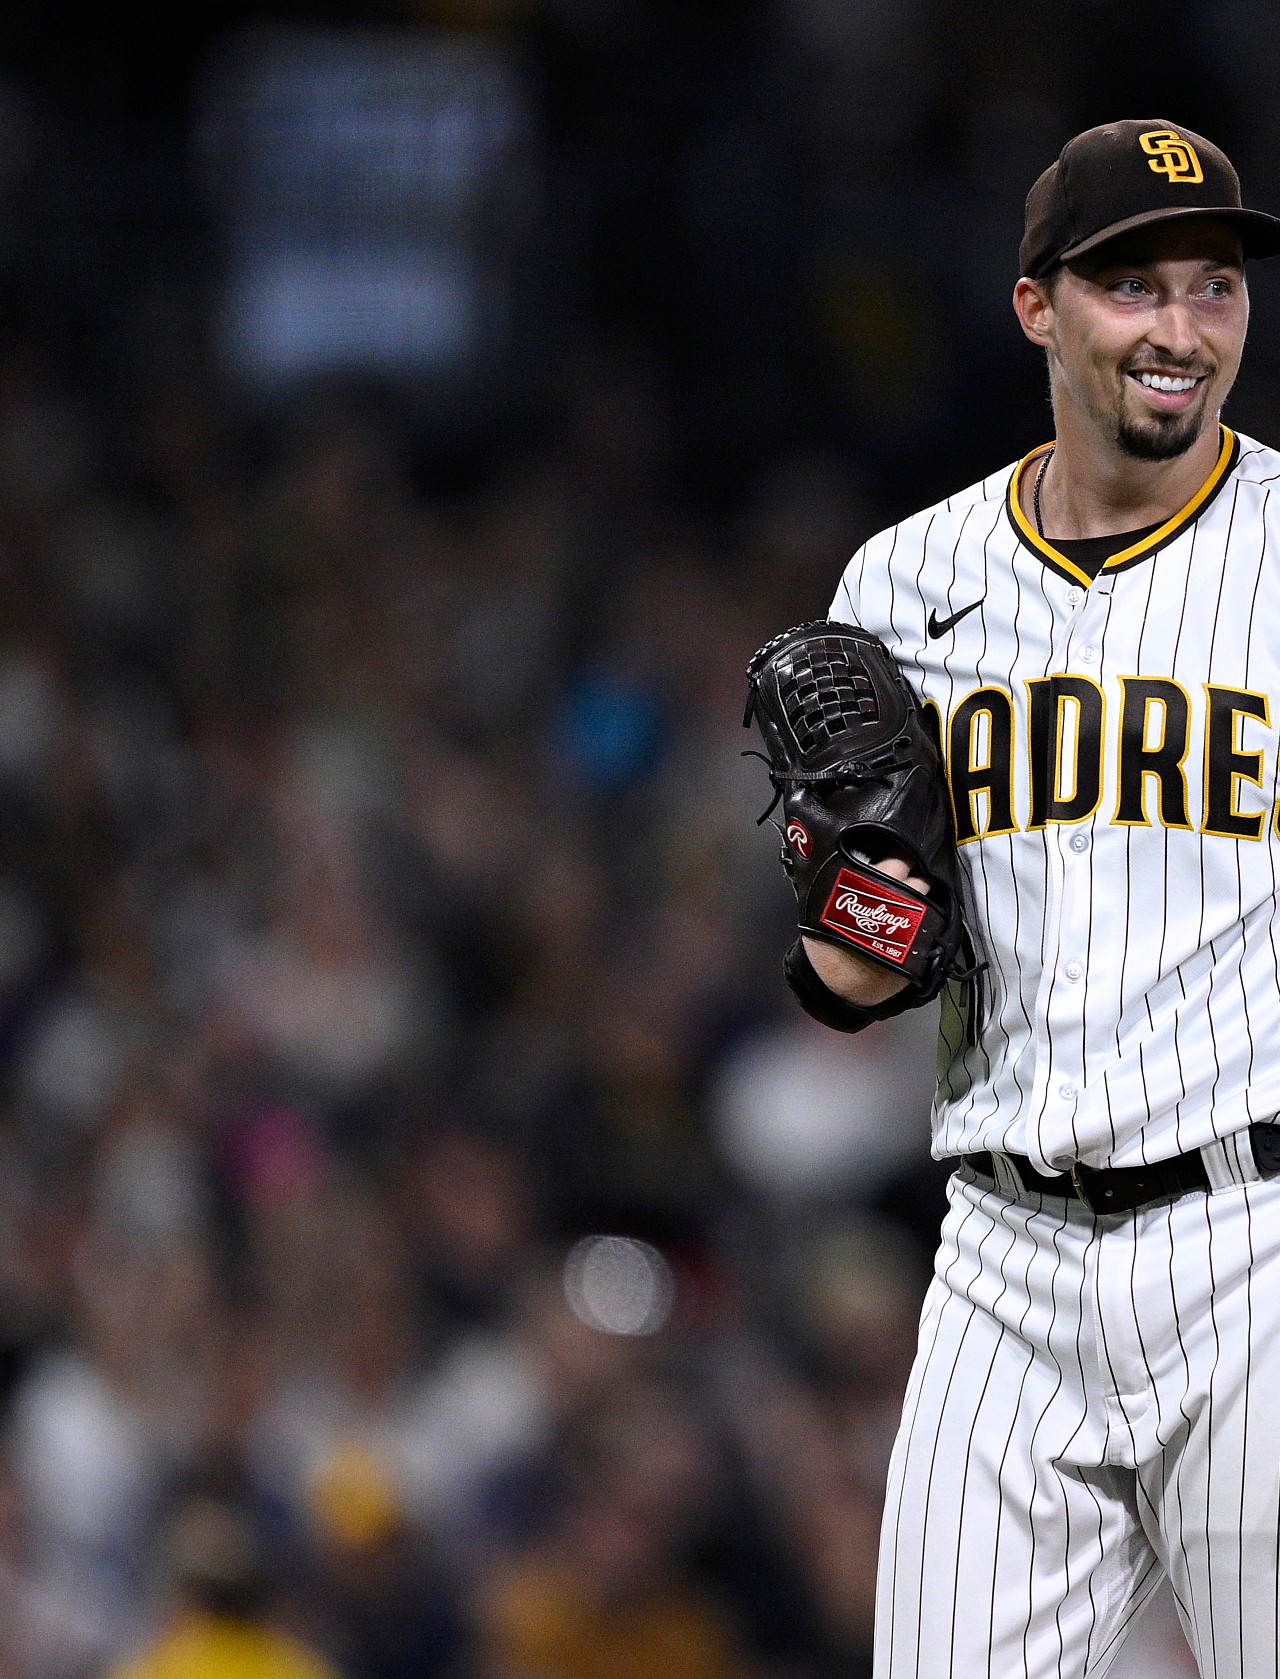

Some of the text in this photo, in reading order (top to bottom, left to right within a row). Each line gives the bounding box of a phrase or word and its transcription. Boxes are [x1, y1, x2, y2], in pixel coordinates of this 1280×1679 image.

[1138, 129, 1204, 184] SD
[835, 892, 912, 935] Rawlings
[885, 946, 902, 958] 1887
